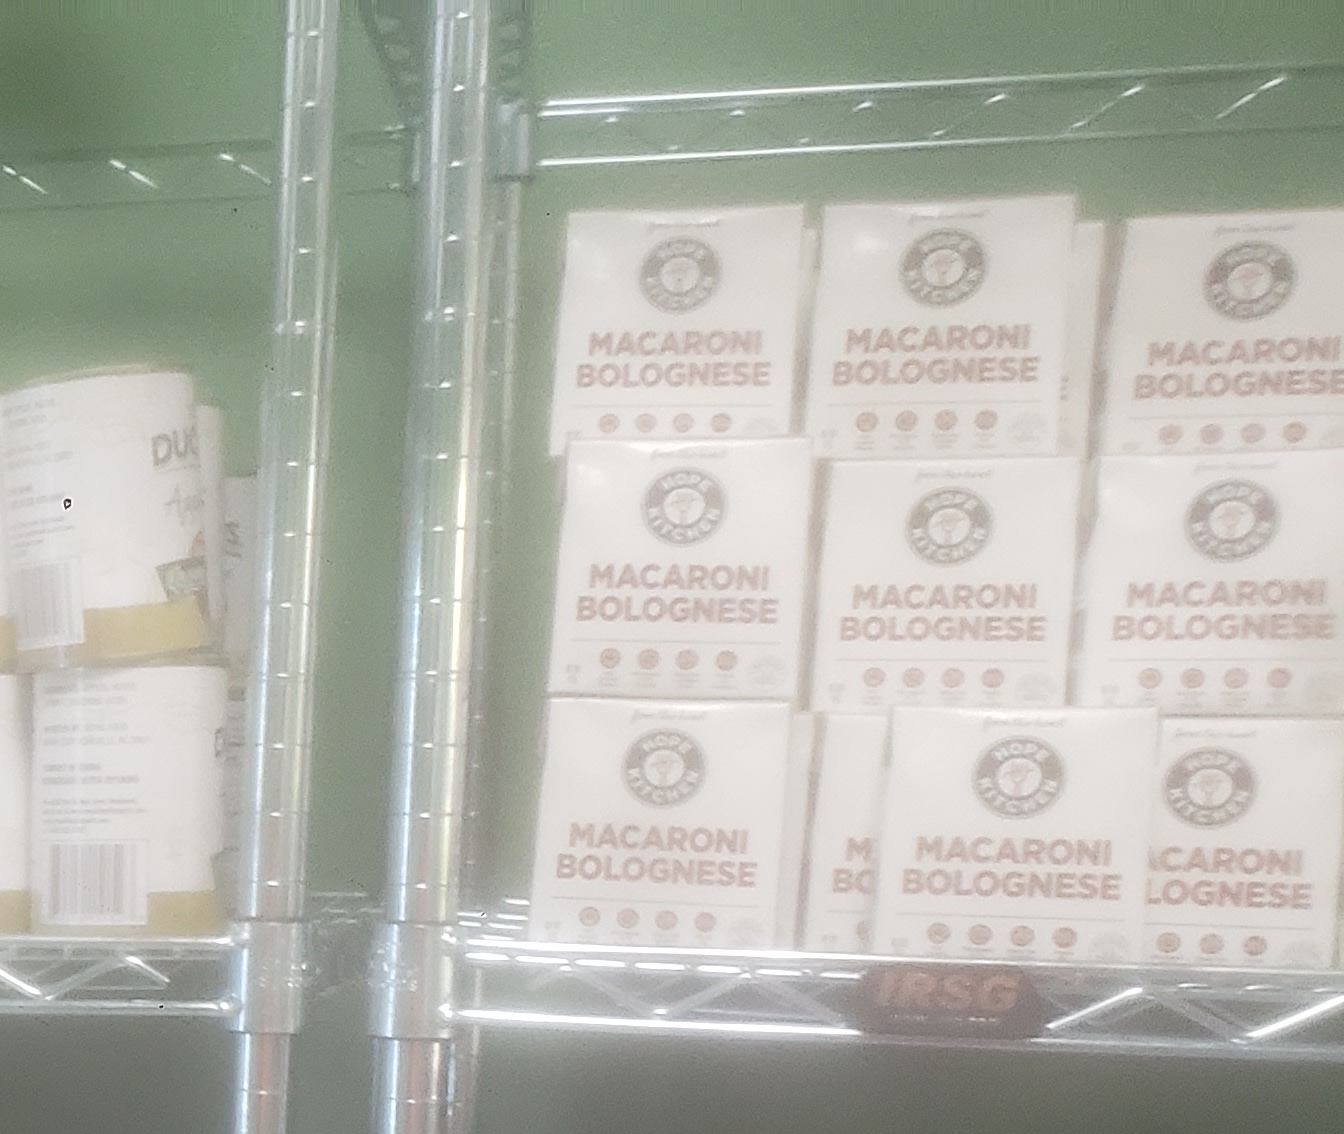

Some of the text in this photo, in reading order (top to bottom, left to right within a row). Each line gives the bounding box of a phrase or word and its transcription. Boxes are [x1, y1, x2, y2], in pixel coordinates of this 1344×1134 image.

[588, 330, 762, 356] MACARONI
[845, 323, 1031, 353] MACARONI
[1147, 336, 1342, 366] MACARONI
[576, 361, 771, 388] BOLOGNESE
[831, 356, 1040, 386] BOLOGNESE
[1134, 369, 1344, 400] BOLOGNESE
[588, 563, 771, 591] MACARONI
[852, 583, 1038, 609] MACARONI
[1127, 577, 1328, 608] MACARONI
[575, 595, 779, 624] BOLOGNESE
[839, 615, 1047, 642] BOLOGNESE
[1112, 613, 1336, 641] BOLOGNESE
[569, 822, 749, 855] MACARONI
[916, 836, 1111, 866] MACARONI
[556, 853, 758, 888] BOLOGNESE
[902, 868, 1123, 901] BOLOGNESE
